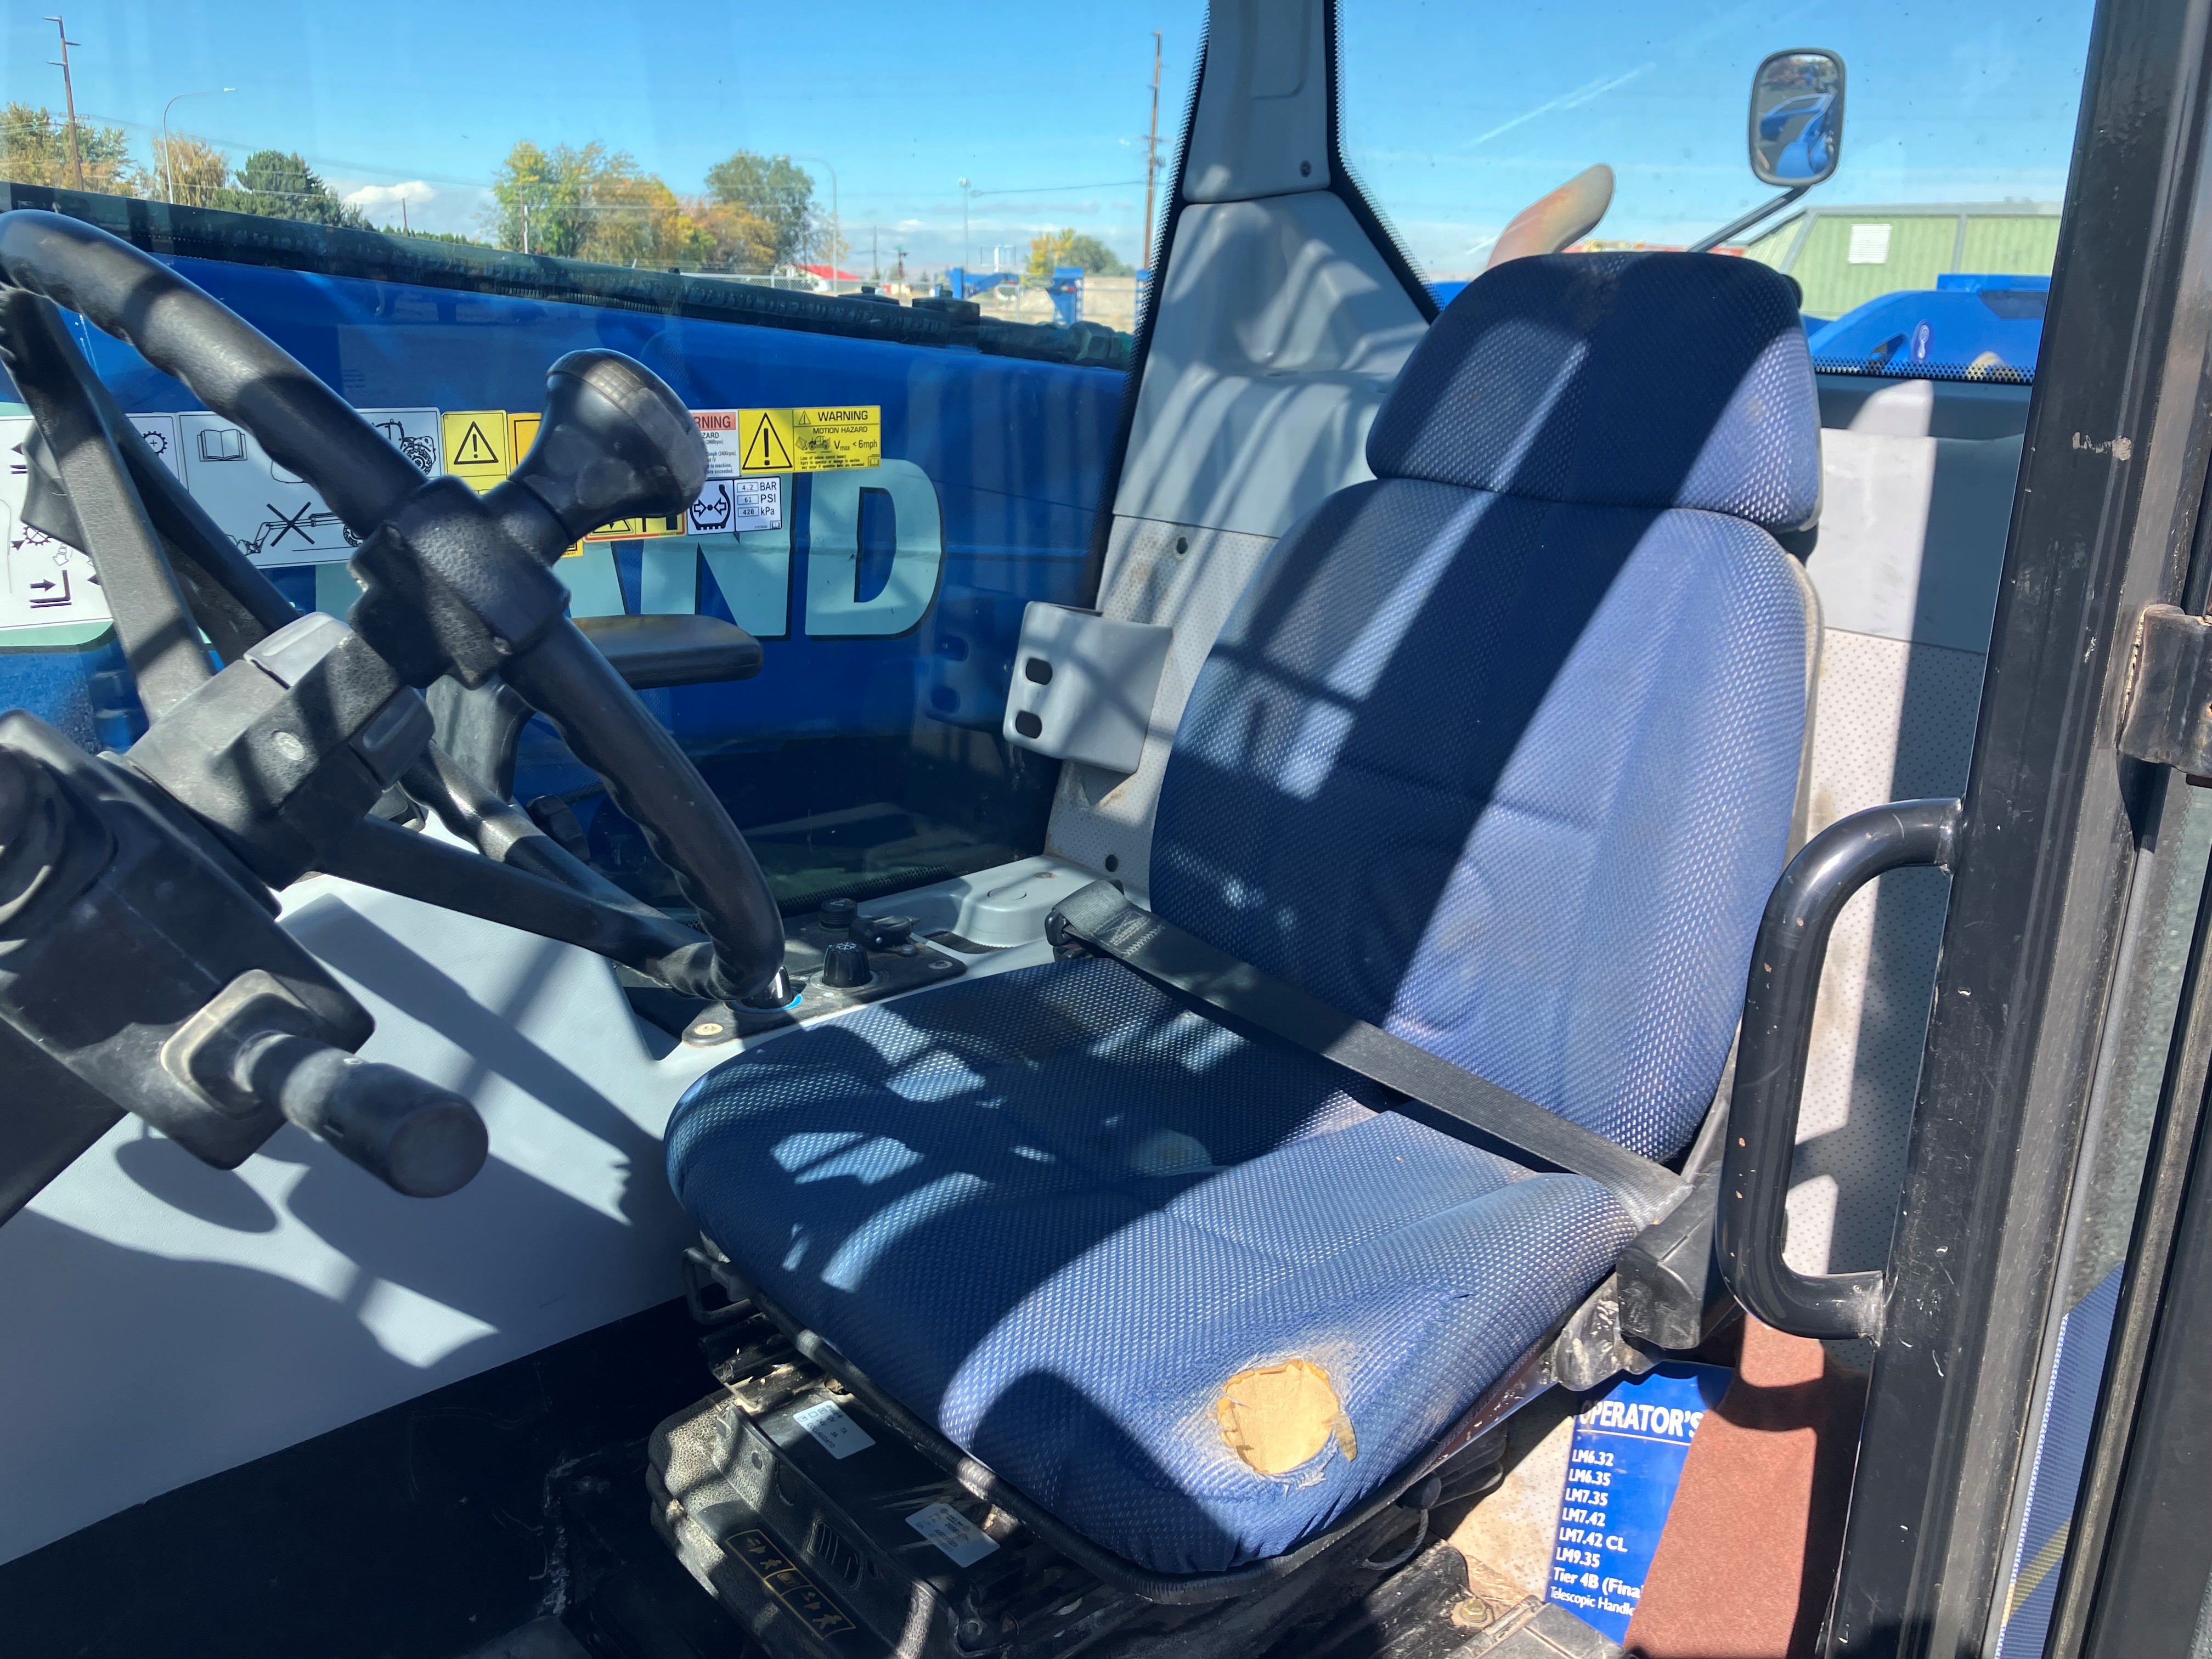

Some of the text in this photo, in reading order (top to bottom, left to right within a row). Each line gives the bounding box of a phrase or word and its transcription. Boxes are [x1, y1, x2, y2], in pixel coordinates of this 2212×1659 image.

[694, 415, 731, 428] RNING
[818, 410, 868, 421] WARNING
[859, 439, 878, 450] 6mph
[760, 482, 777, 490] BAR
[760, 494, 776, 503] PSI
[761, 506, 775, 516] kPa
[1572, 1449, 1615, 1466] LM6.32
[1568, 1468, 1611, 1486] LM6.35
[1565, 1487, 1609, 1506] LM7.35
[1562, 1507, 1606, 1527] LM7.42
[1559, 1527, 1628, 1553] LM7.42 CL
[1555, 1547, 1601, 1567] LM9.35
[1554, 1566, 1644, 1599] Tier 4B (Fina
[1550, 1586, 1596, 1608] Telescopic
